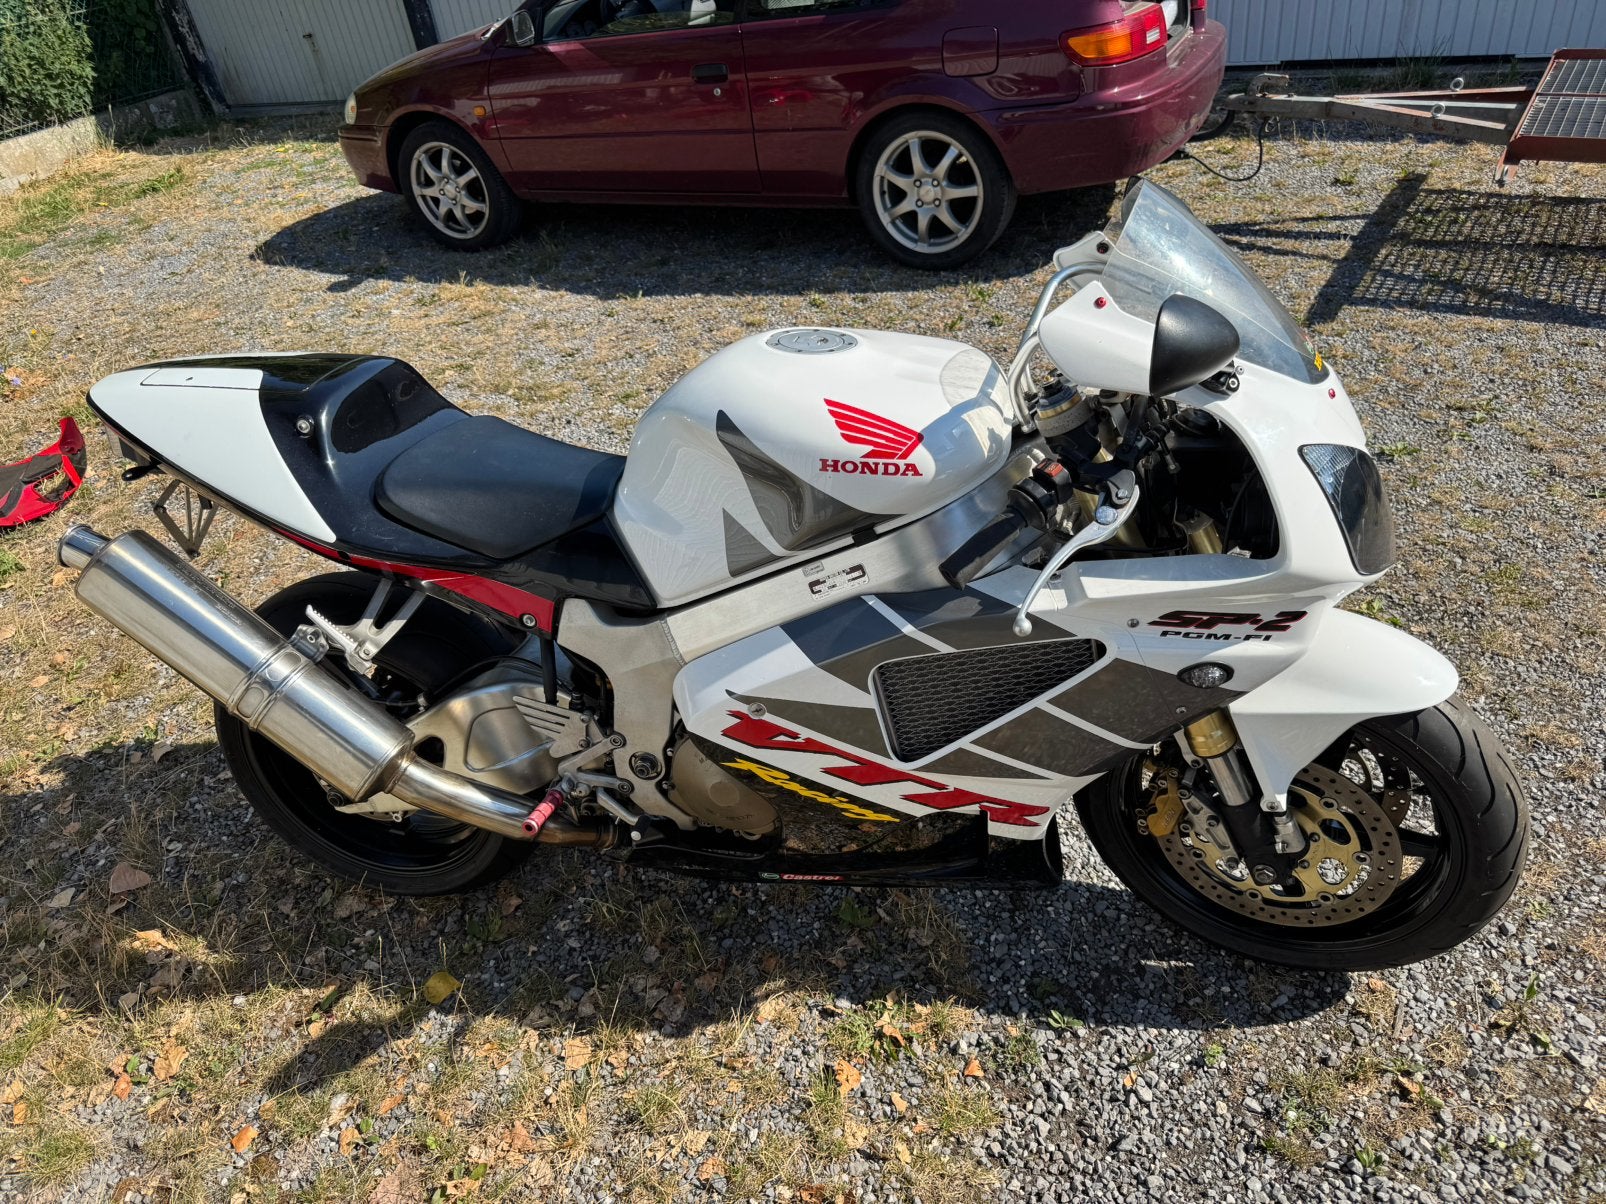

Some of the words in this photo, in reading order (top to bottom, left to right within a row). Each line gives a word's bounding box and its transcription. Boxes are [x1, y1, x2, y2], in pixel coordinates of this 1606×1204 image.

[819, 458, 923, 477] HONDA
[1147, 610, 1308, 632] SP-2
[1160, 630, 1273, 642] PGM-FI
[721, 709, 1051, 827] VTR
[720, 757, 900, 823] Racing
